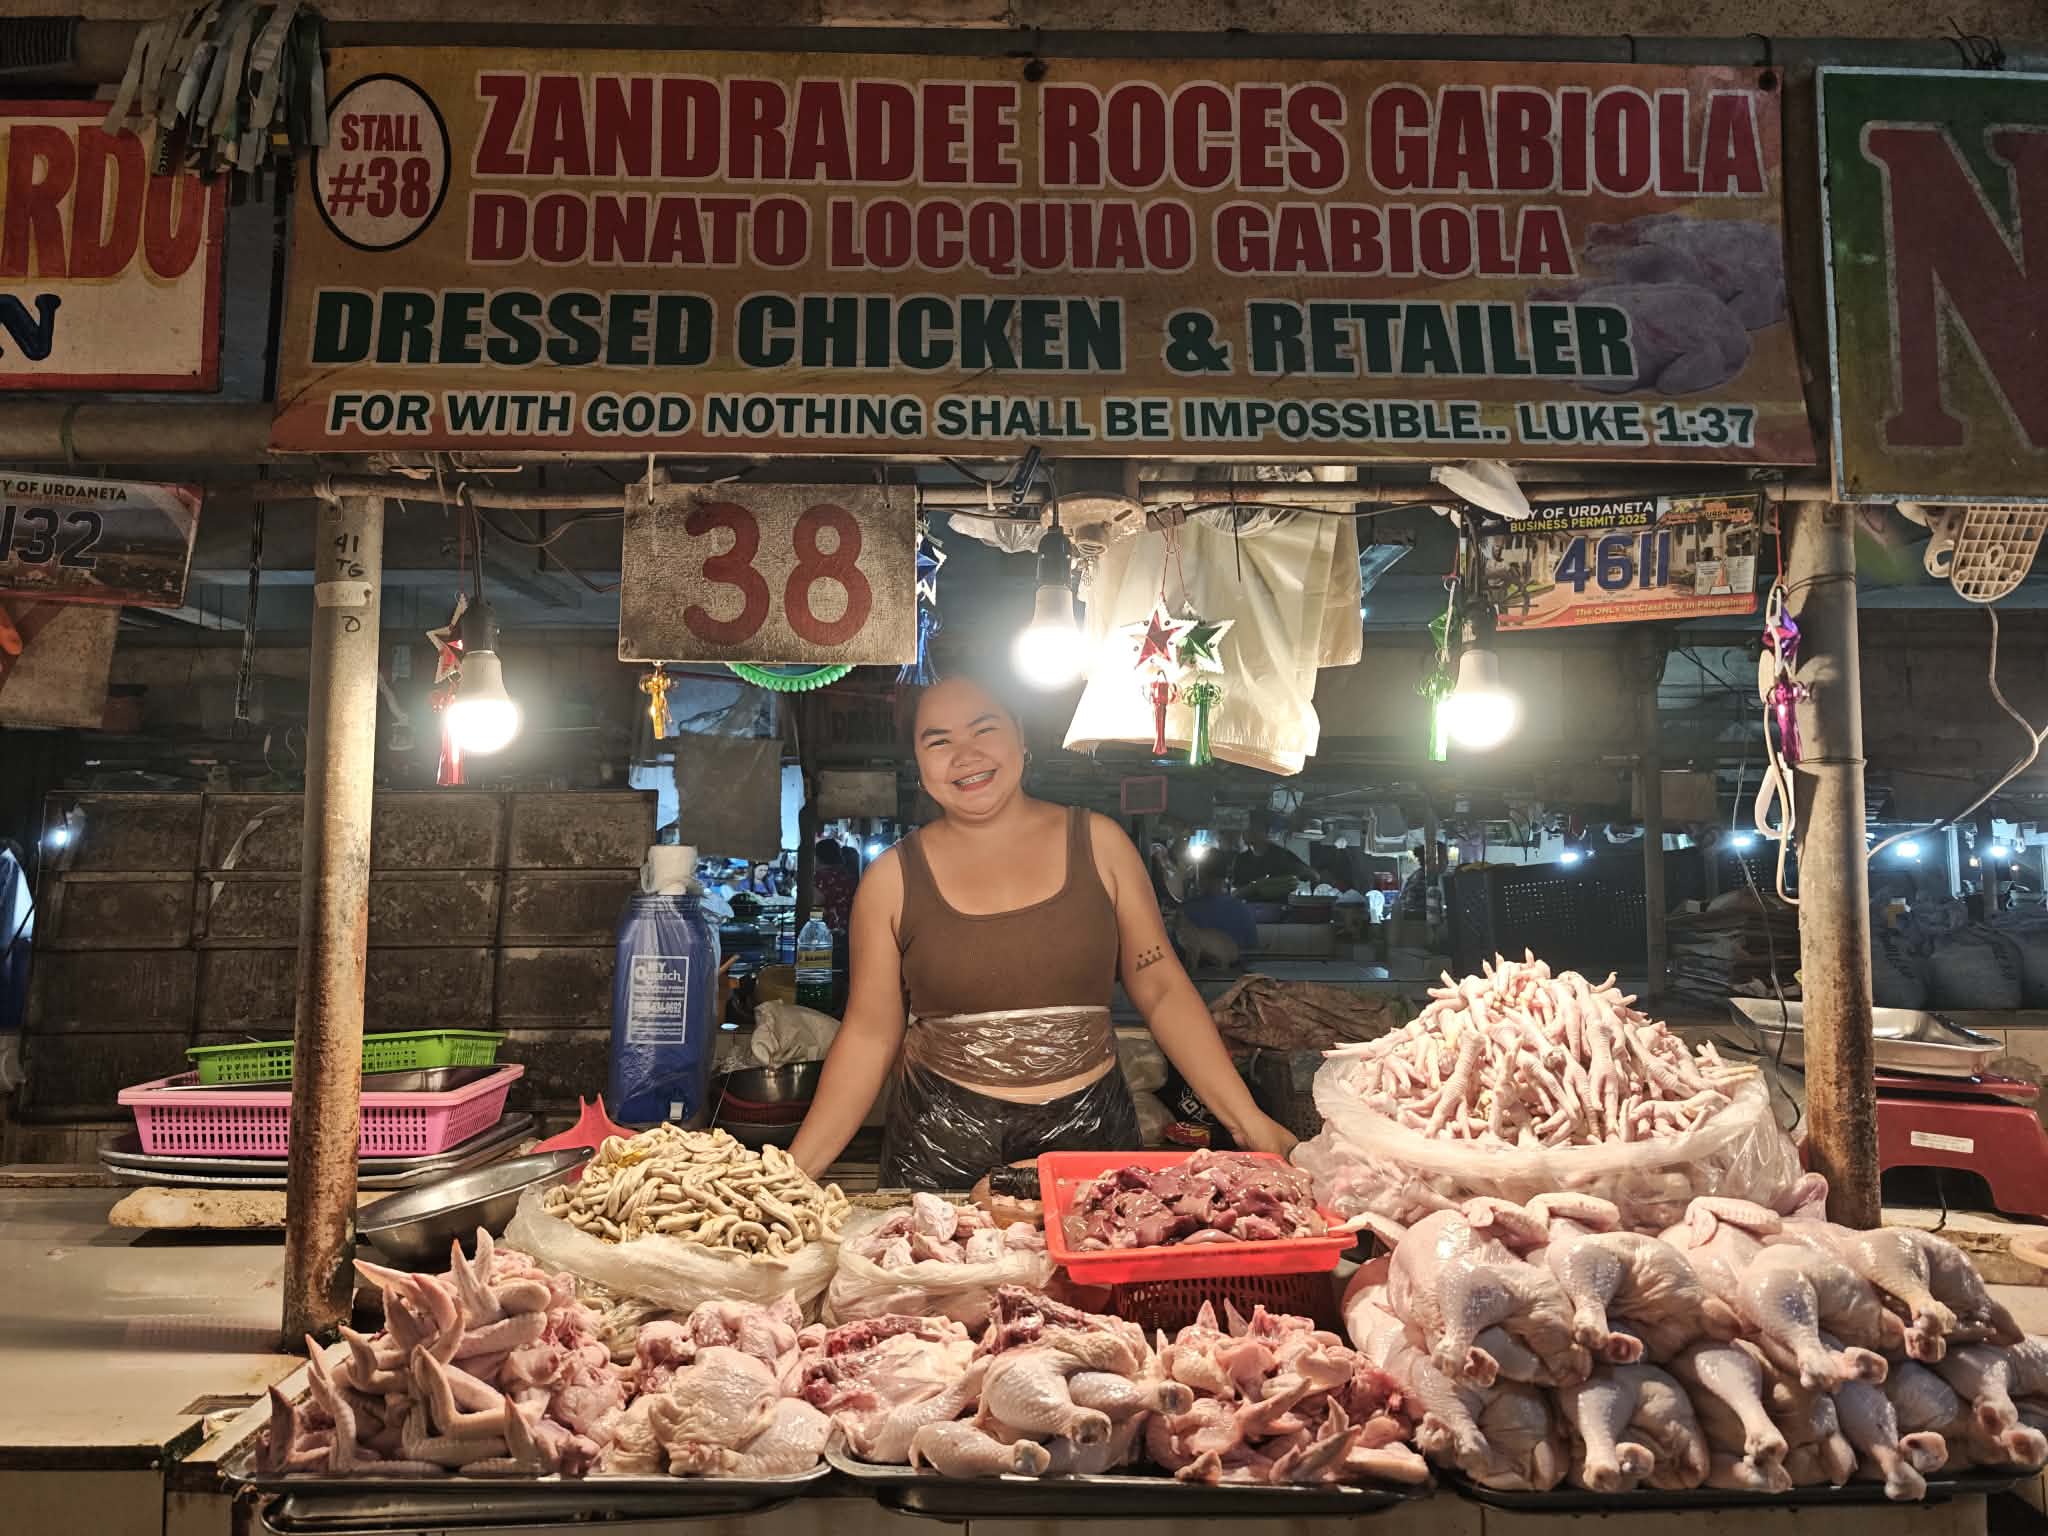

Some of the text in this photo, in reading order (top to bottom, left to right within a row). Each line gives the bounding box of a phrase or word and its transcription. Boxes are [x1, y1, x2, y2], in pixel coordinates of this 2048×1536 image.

[340, 114, 422, 152] STALL
[476, 74, 1765, 194] ZANDRADEE ROCES GABIOLA
[328, 156, 431, 218] #38
[471, 193, 1576, 276] DONATO LOCQUIAO GABIOLA
[311, 291, 1634, 377] DRESSED CHICKEN & RETAILER
[330, 394, 431, 432] FOR
[446, 395, 572, 432] WITH
[587, 395, 691, 433] GOD
[707, 398, 922, 434] NOTHING
[936, 398, 1090, 437] SHALL
[1105, 401, 1169, 437] BE
[1522, 405, 1646, 443] LUKE
[1656, 407, 1754, 445] 1:37
[16, 481, 39, 495] OF
[42, 482, 128, 502] URDANETA
[1543, 507, 1565, 519] OF
[1568, 501, 1654, 518] URDANETA
[1510, 513, 1648, 533] BUSINESS PERMIT 2025
[683, 501, 873, 646] 38
[1553, 530, 1671, 594] 4611
